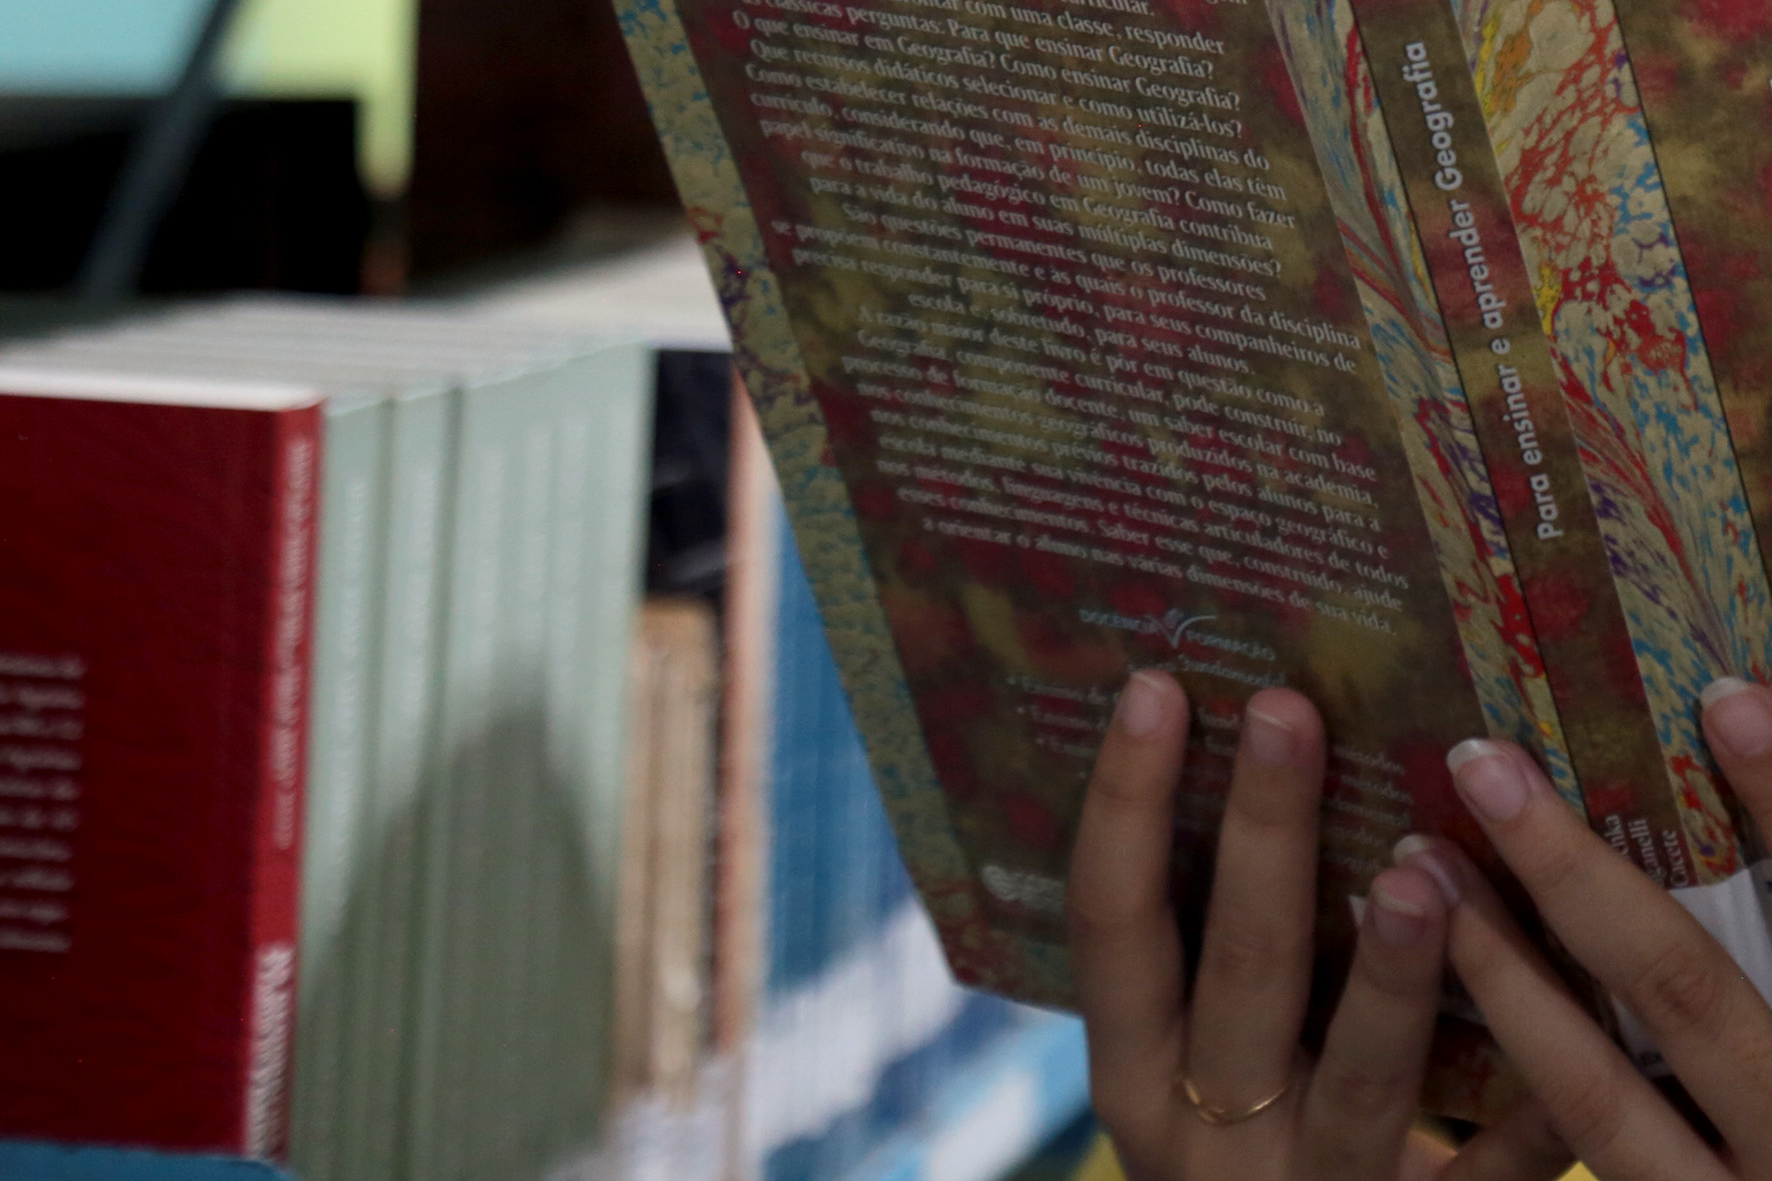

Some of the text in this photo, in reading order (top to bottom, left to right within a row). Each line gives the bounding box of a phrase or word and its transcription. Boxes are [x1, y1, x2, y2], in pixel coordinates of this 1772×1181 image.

[944, 17, 992, 43] Para
[992, 29, 1032, 51] que
[1033, 36, 1107, 62] ensinar
[1106, 44, 1217, 81] Geografia?
[1008, 5, 1054, 27] uma
[1123, 24, 1228, 56] responder
[747, 36, 791, 62] Que
[791, 47, 872, 74] recursos
[870, 56, 960, 89] didáticos
[960, 74, 1060, 106] selecionar
[1076, 95, 1135, 119] como
[1135, 105, 1246, 139] utilizá-los?
[751, 15, 791, 36] que
[790, 21, 862, 46] ensinar
[862, 33, 895, 52] em
[894, 34, 998, 69] Geografia?
[997, 51, 1058, 79] Como
[1058, 65, 1133, 92] ensinar
[1132, 74, 1244, 112] Geografia?
[741, 61, 803, 88] Como
[910, 92, 990, 120] relações
[990, 106, 1035, 128] com
[1035, 114, 1060, 133] as
[1059, 114, 1133, 146] demais
[1132, 127, 1241, 165] disciplinas
[1240, 147, 1271, 171] do
[839, 105, 967, 141] considerando
[1012, 135, 1046, 155] em
[1143, 157, 1201, 184] todas
[1202, 168, 1245, 193] elas
[1245, 176, 1288, 201] têm
[926, 146, 1298, 229] na formação de um jovem? Como fazer
[807, 174, 853, 196] para
[868, 183, 910, 206] vida
[909, 188, 939, 211] do
[939, 195, 996, 221] aluno
[996, 208, 1030, 228] em
[1030, 214, 1076, 236] suas
[1076, 222, 1169, 254] múltiplas
[1168, 237, 1286, 278] dimensões?
[1047, 192, 1081, 212] em
[1080, 195, 1176, 231] Geografia
[1177, 217, 1274, 250] contribua
[963, 227, 1267, 301] permanentes que os professores
[1403, 41, 1563, 542] Para ensinar e aprender Geografia
[1092, 325, 1138, 348] para
[1139, 335, 1184, 358] seus
[1100, 303, 1148, 326] para
[1148, 313, 1193, 336] seus
[1193, 323, 1330, 368] companheiros
[1330, 350, 1359, 375] de
[1146, 288, 1363, 350] professor da disciplina
[1170, 392, 1221, 417] pode
[1316, 427, 1343, 447] no
[1254, 462, 1282, 481] na
[1287, 444, 1378, 481] com base
[1274, 515, 1375, 555] geográfico
[1324, 549, 1410, 591] de todos
